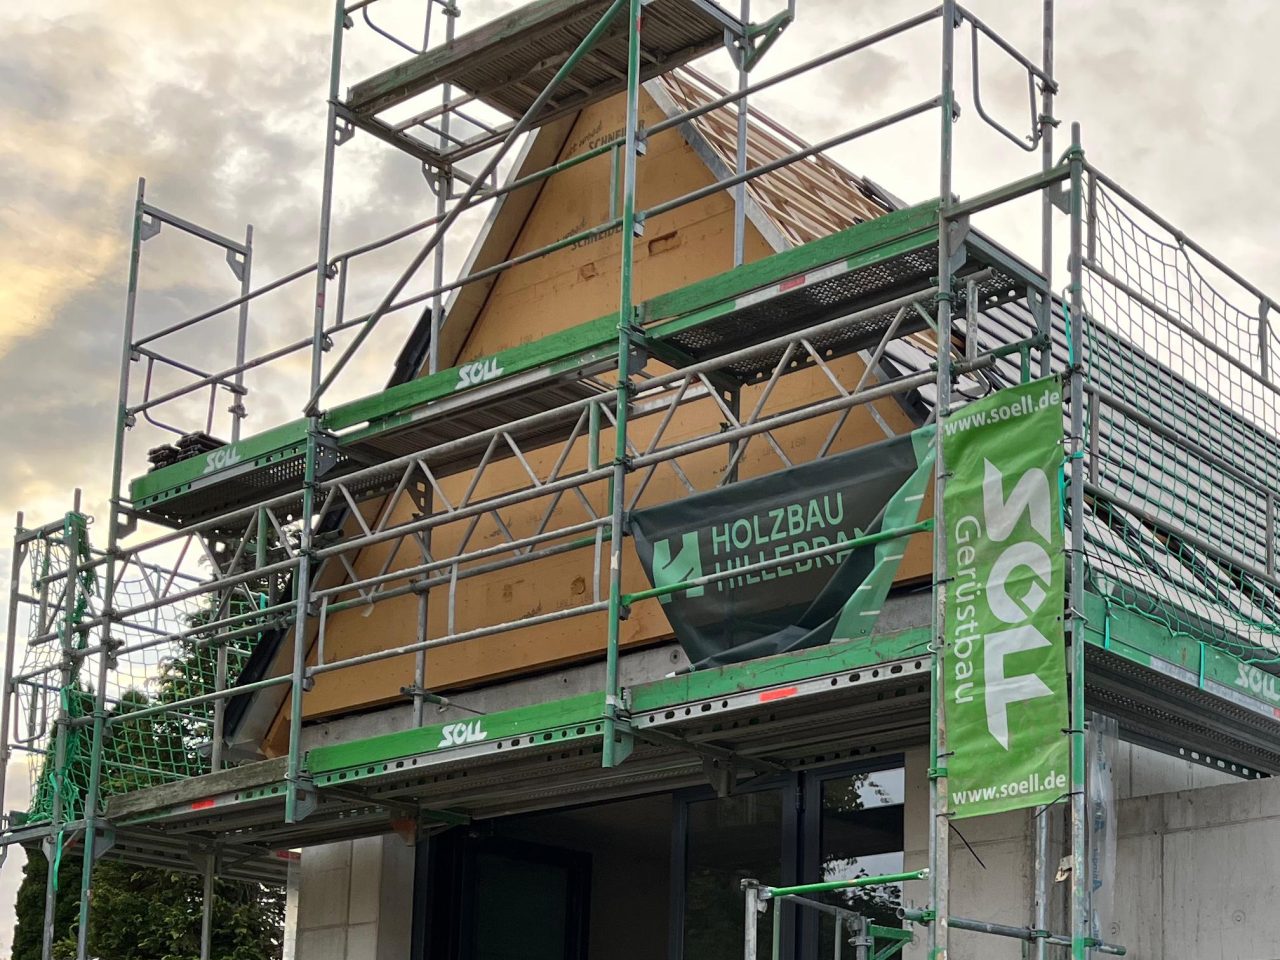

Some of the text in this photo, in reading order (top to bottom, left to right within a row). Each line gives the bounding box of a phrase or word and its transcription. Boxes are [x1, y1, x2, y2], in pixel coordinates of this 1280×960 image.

[945, 390, 1060, 437] www.soell.de
[712, 492, 843, 555] HOLZBAU
[954, 515, 981, 704] Gerüstbau
[953, 771, 1066, 805] www.soell.de
